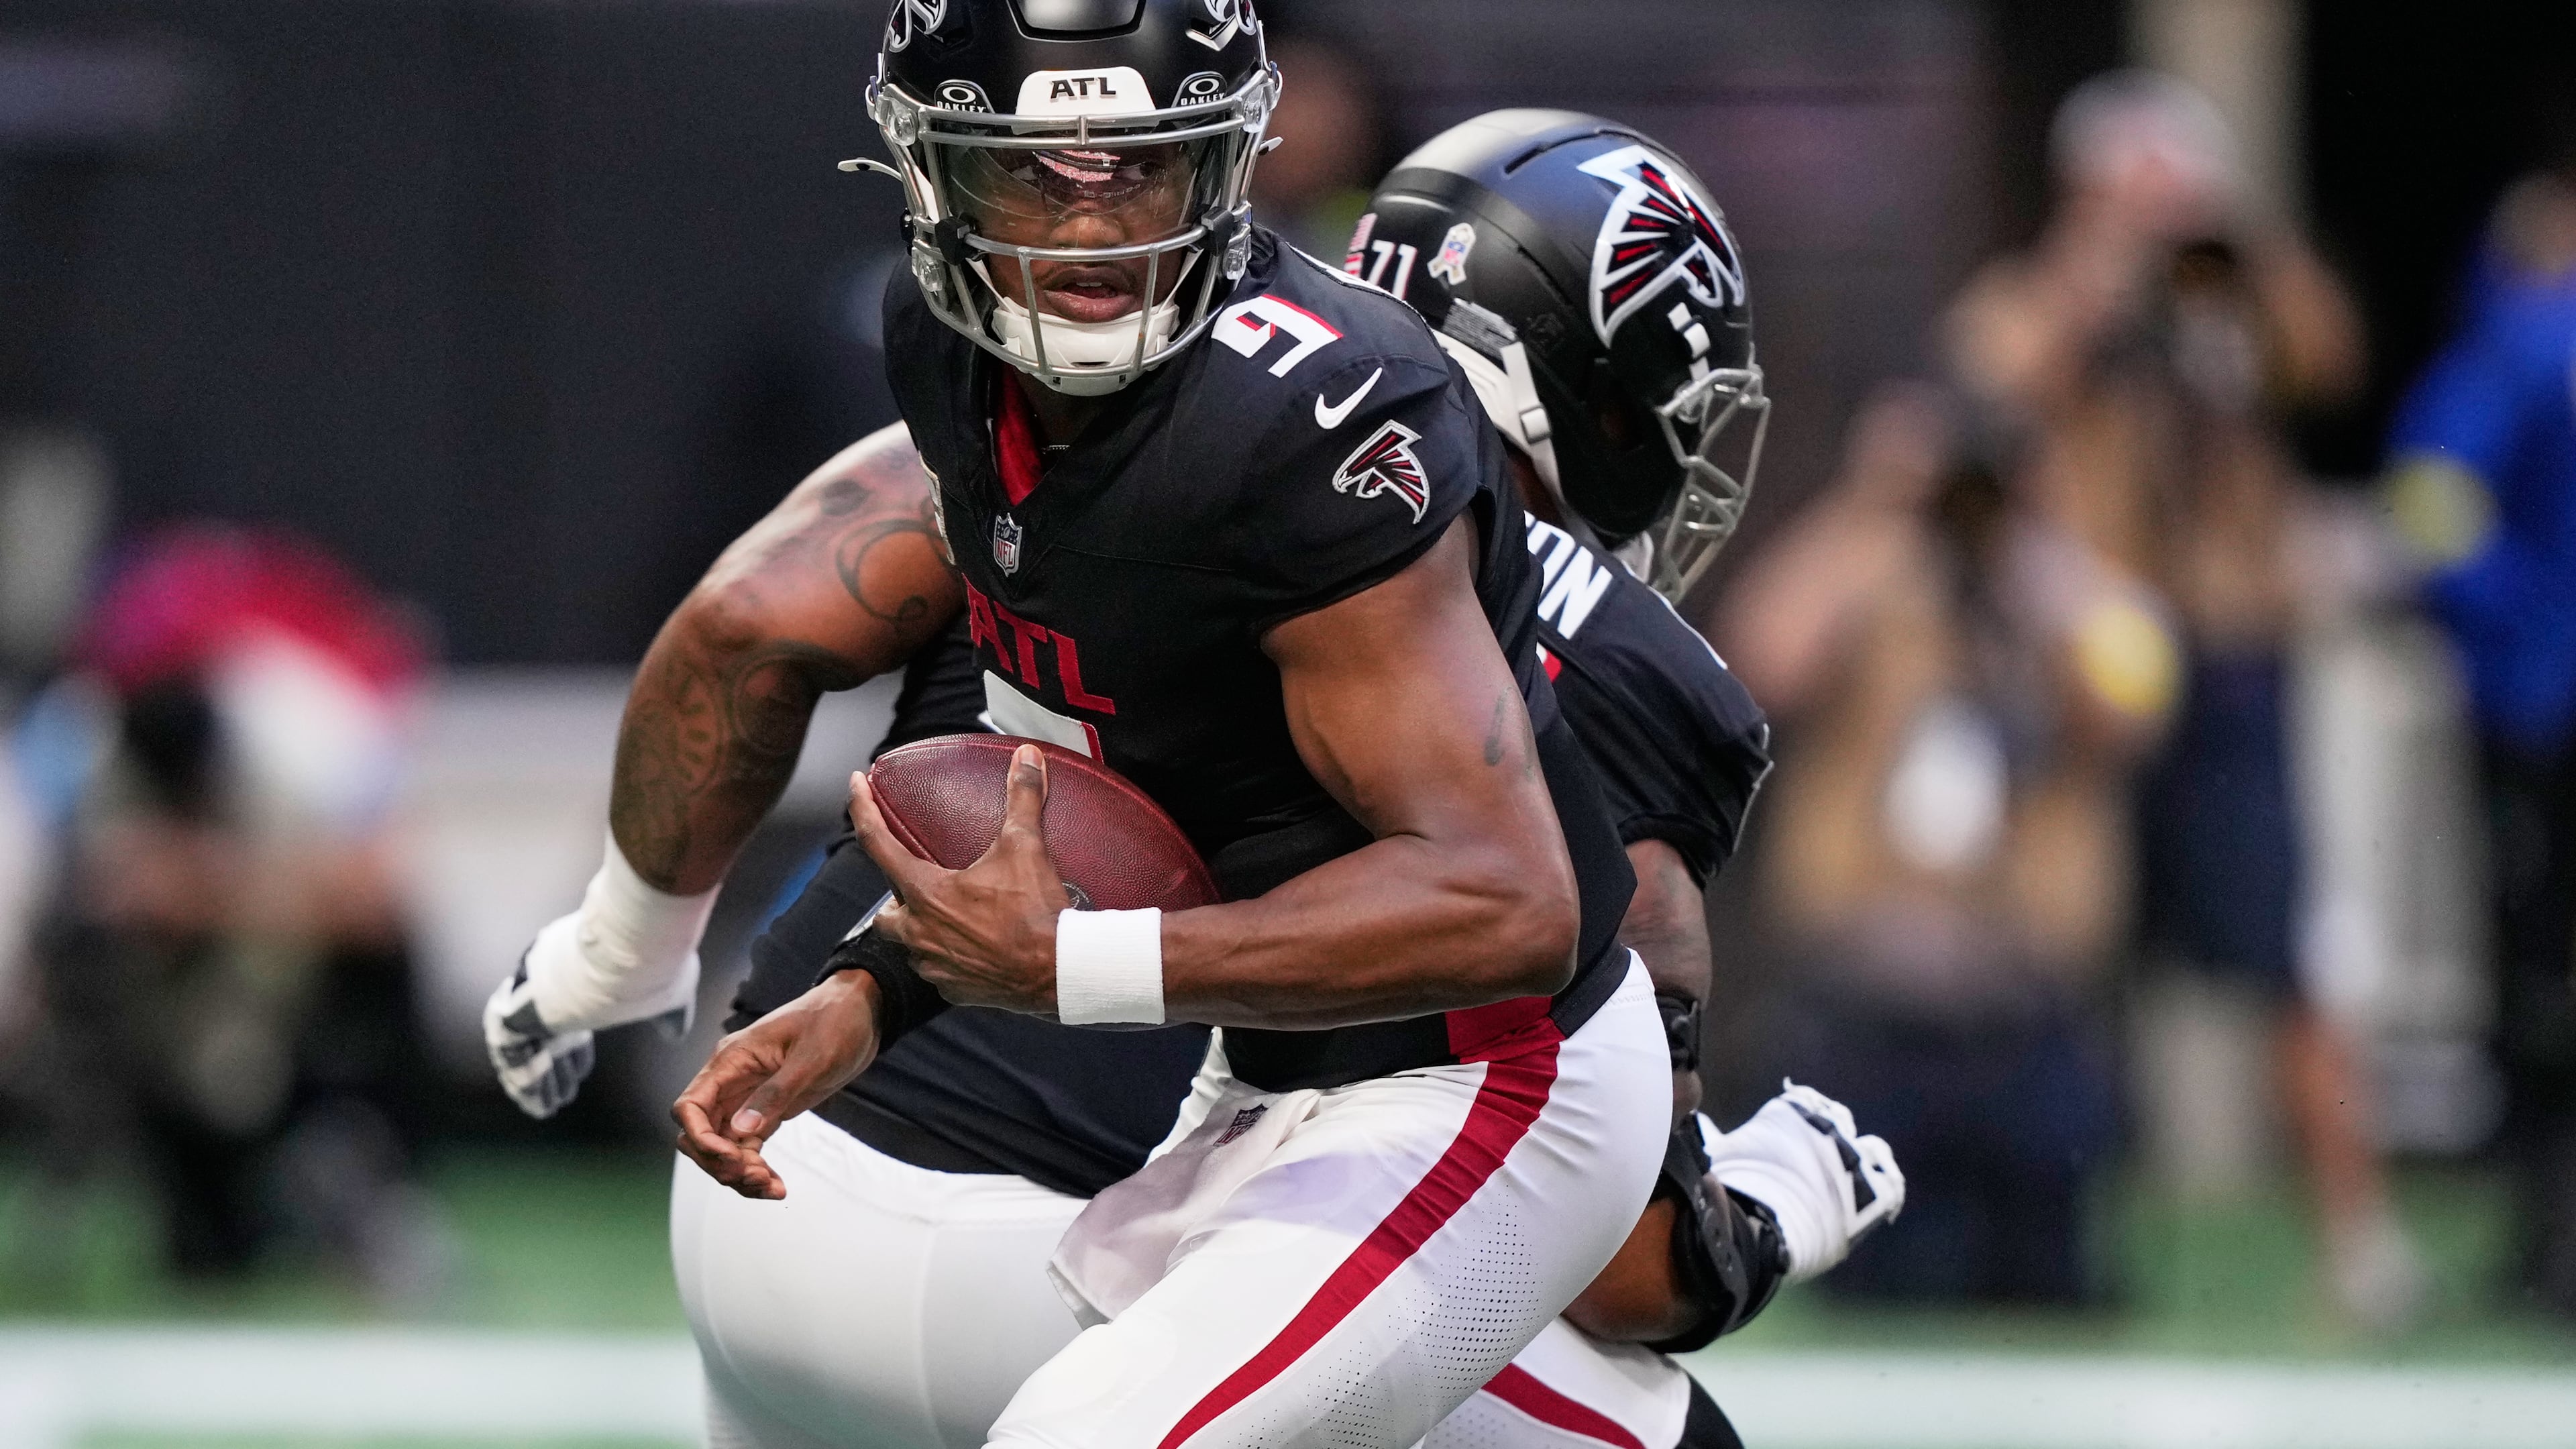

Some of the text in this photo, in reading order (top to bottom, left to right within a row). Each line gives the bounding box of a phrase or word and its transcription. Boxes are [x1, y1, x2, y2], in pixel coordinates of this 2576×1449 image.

[936, 101, 985, 113] OAKLEY
[1050, 77, 1116, 99] ATL
[1181, 92, 1225, 106] OAKLEY
[1367, 239, 1418, 300] 71
[1211, 293, 1344, 378] 9
[997, 539, 1014, 565] NFL
[1523, 510, 1613, 640] ON
[961, 572, 1116, 716] ATL
